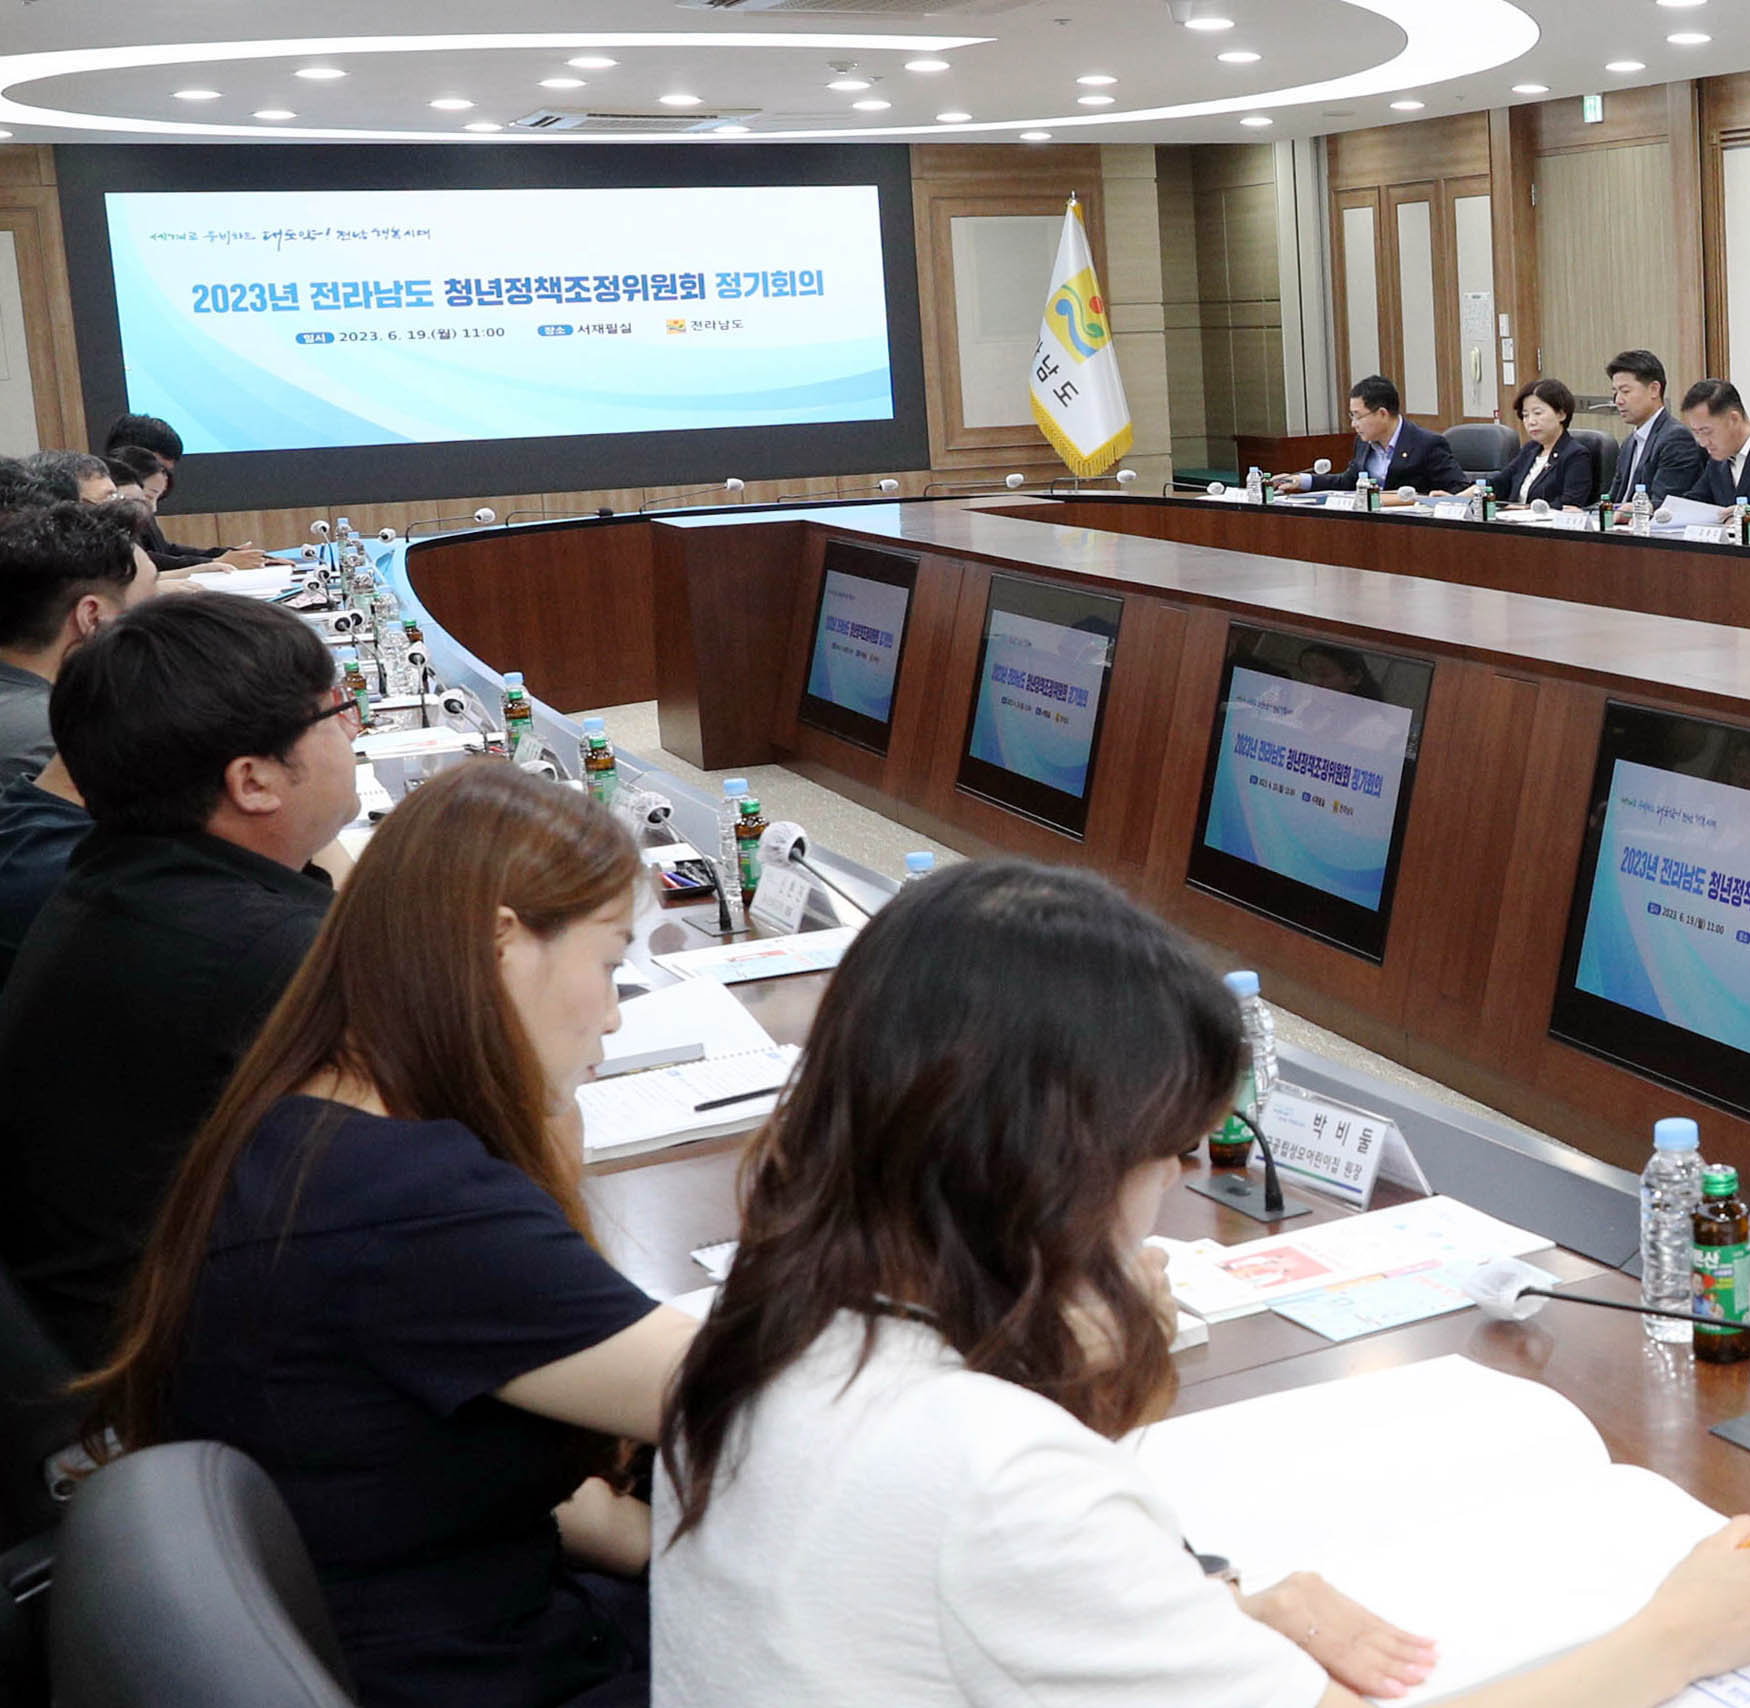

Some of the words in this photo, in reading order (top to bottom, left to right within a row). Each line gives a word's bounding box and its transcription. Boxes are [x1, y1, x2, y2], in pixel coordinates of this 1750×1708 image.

[191, 281, 299, 315] 2023년
[308, 277, 435, 312] 전라남도
[444, 272, 706, 307] 청년정책조정위원회
[715, 268, 824, 300] 정기회의
[463, 327, 505, 338] 11:00
[577, 322, 632, 335] 서재필실
[690, 318, 744, 332] 전라남도
[1620, 846, 1659, 882] 2023년
[1659, 857, 1706, 896] 전라남도
